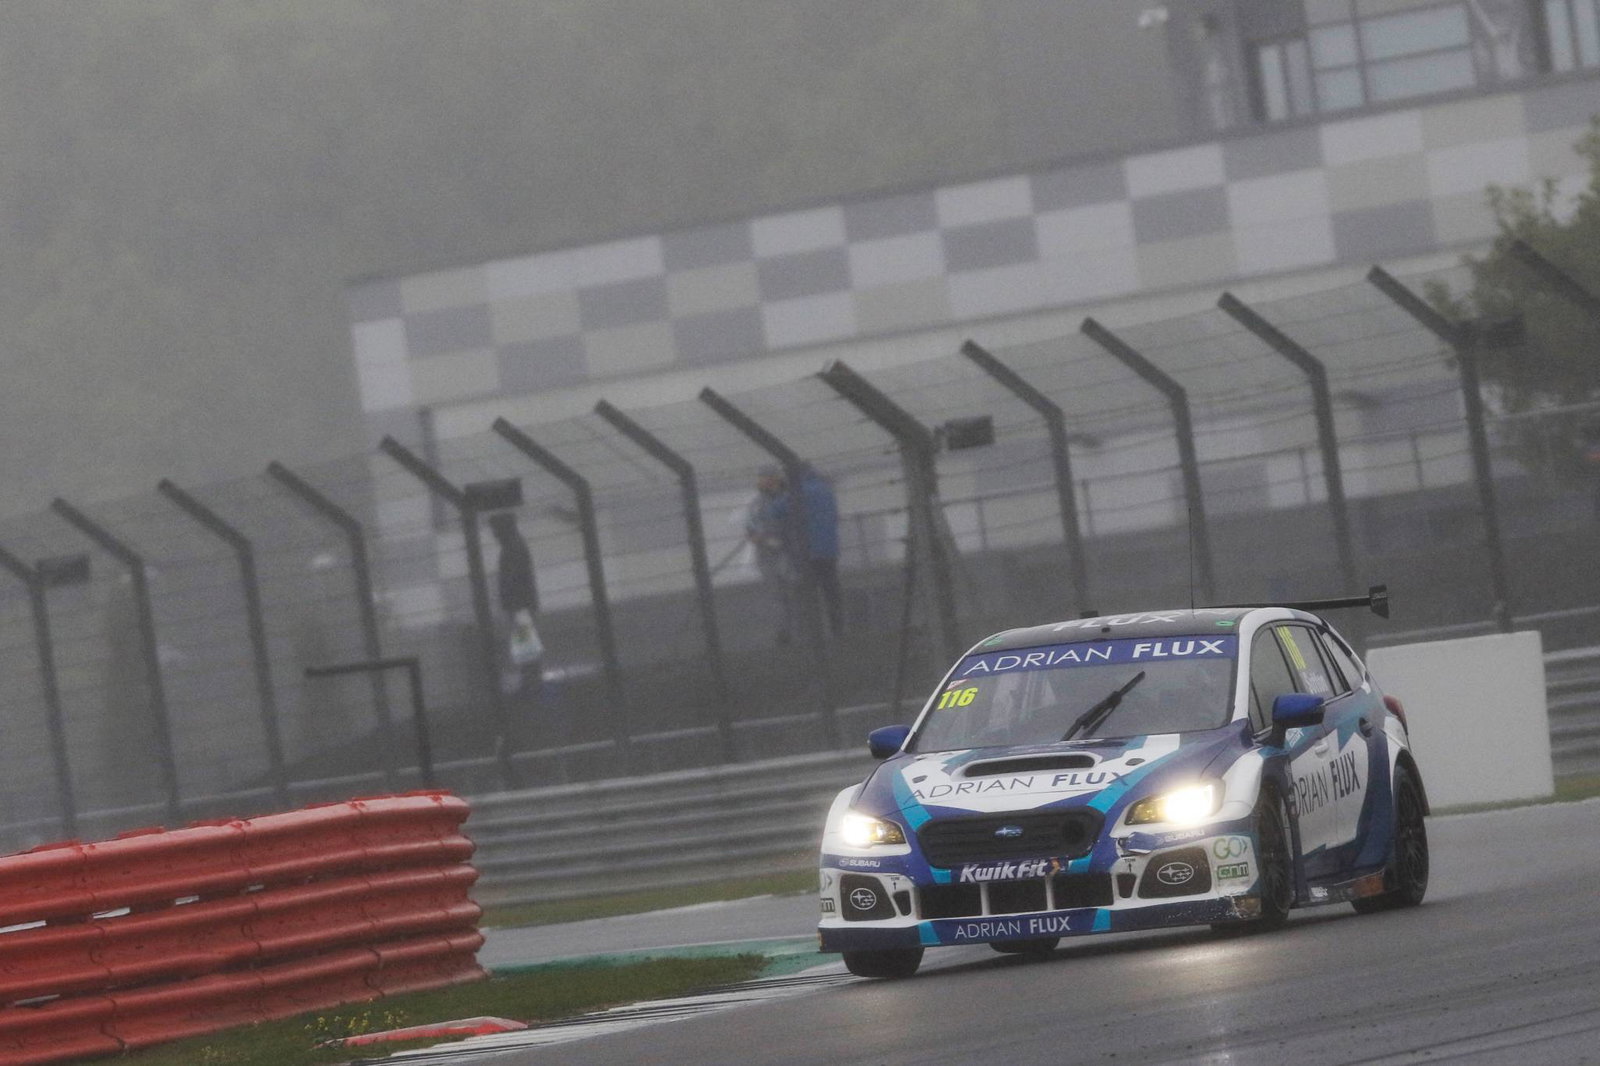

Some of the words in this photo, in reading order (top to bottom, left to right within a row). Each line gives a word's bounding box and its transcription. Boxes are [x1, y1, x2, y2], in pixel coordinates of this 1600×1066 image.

[1053, 611, 1182, 632] FLUX
[963, 646, 1113, 676] ADRIAN
[1132, 639, 1225, 658] FLUX
[937, 687, 979, 711] 116
[903, 776, 1034, 805] ADRIAN
[1051, 771, 1129, 787] FLUX
[1293, 766, 1329, 816] DRIAN
[1329, 751, 1360, 800] FLUX
[849, 860, 880, 868] SUBARU
[955, 921, 1020, 939] ADRIAN
[1029, 916, 1071, 934] FLUX
